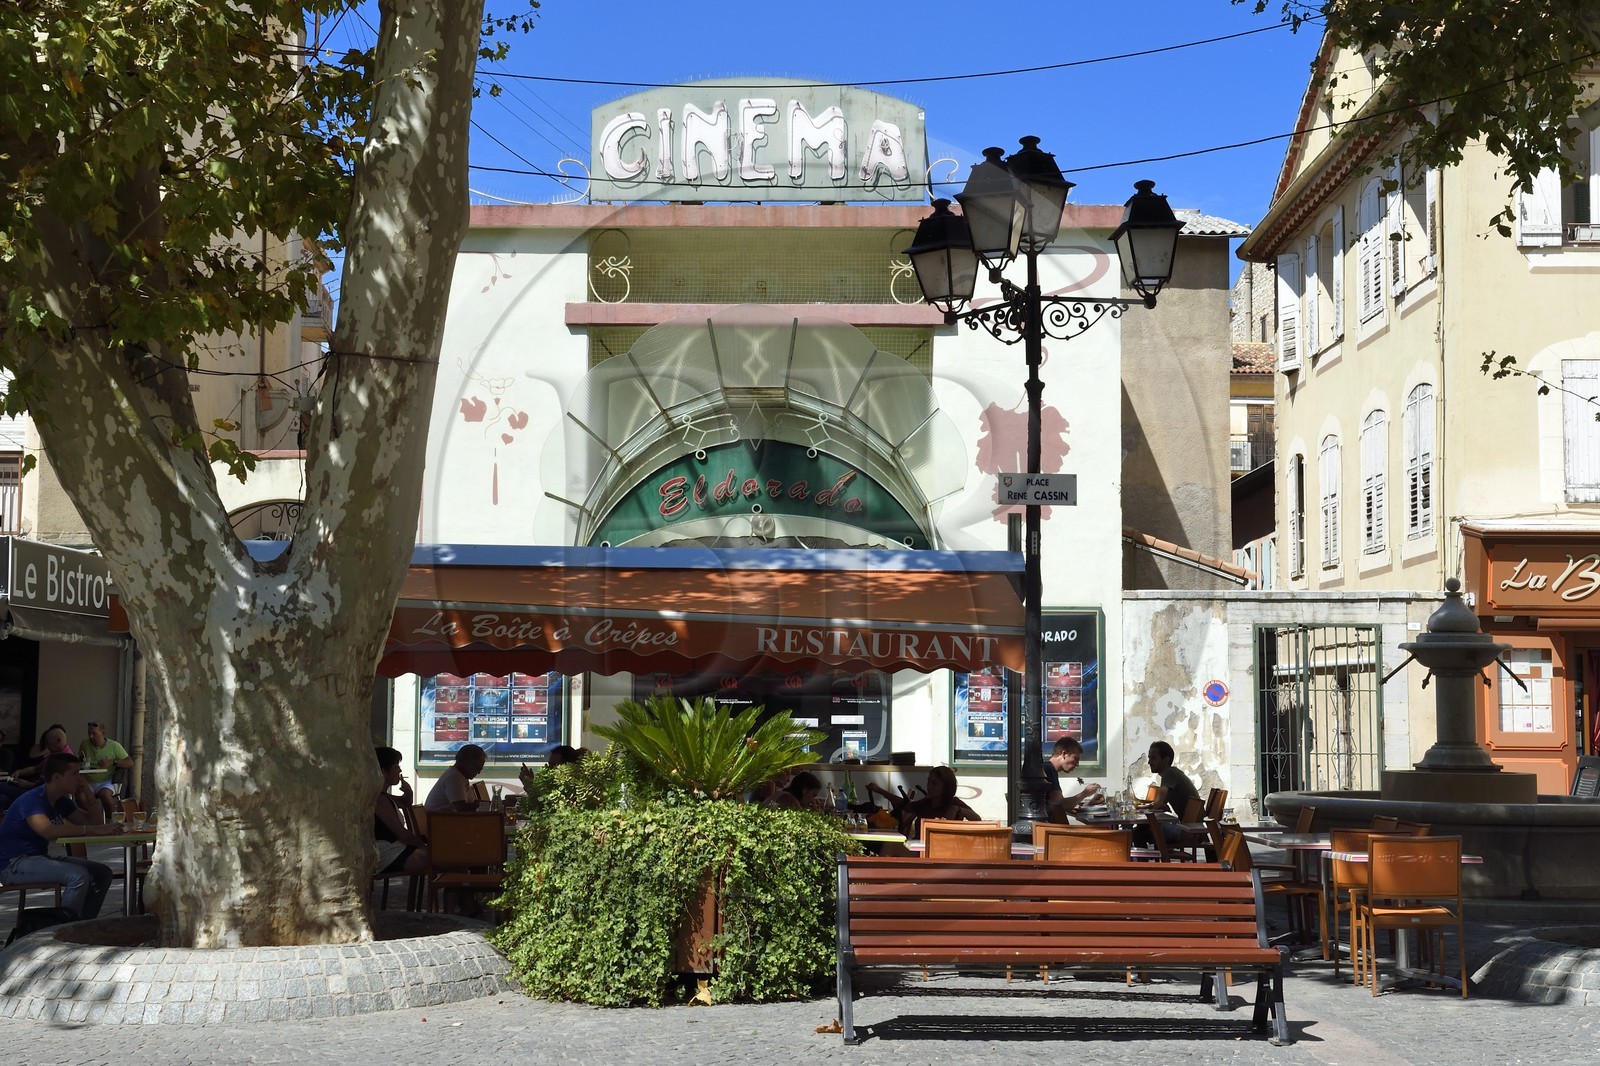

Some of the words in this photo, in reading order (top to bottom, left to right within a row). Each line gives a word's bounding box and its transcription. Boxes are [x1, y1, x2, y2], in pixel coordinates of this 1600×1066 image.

[599, 98, 911, 183] CINEMA
[659, 469, 863, 516] Eldorado
[1026, 478, 1050, 487] PLACE
[1034, 490, 1069, 501] CASSIN
[12, 547, 37, 600] Le
[1500, 557, 1548, 590] La
[413, 611, 460, 637] La
[471, 613, 543, 640] Boîte
[552, 618, 572, 641] à
[584, 618, 680, 650] Crêpes
[755, 626, 999, 663] RESTAURANT
